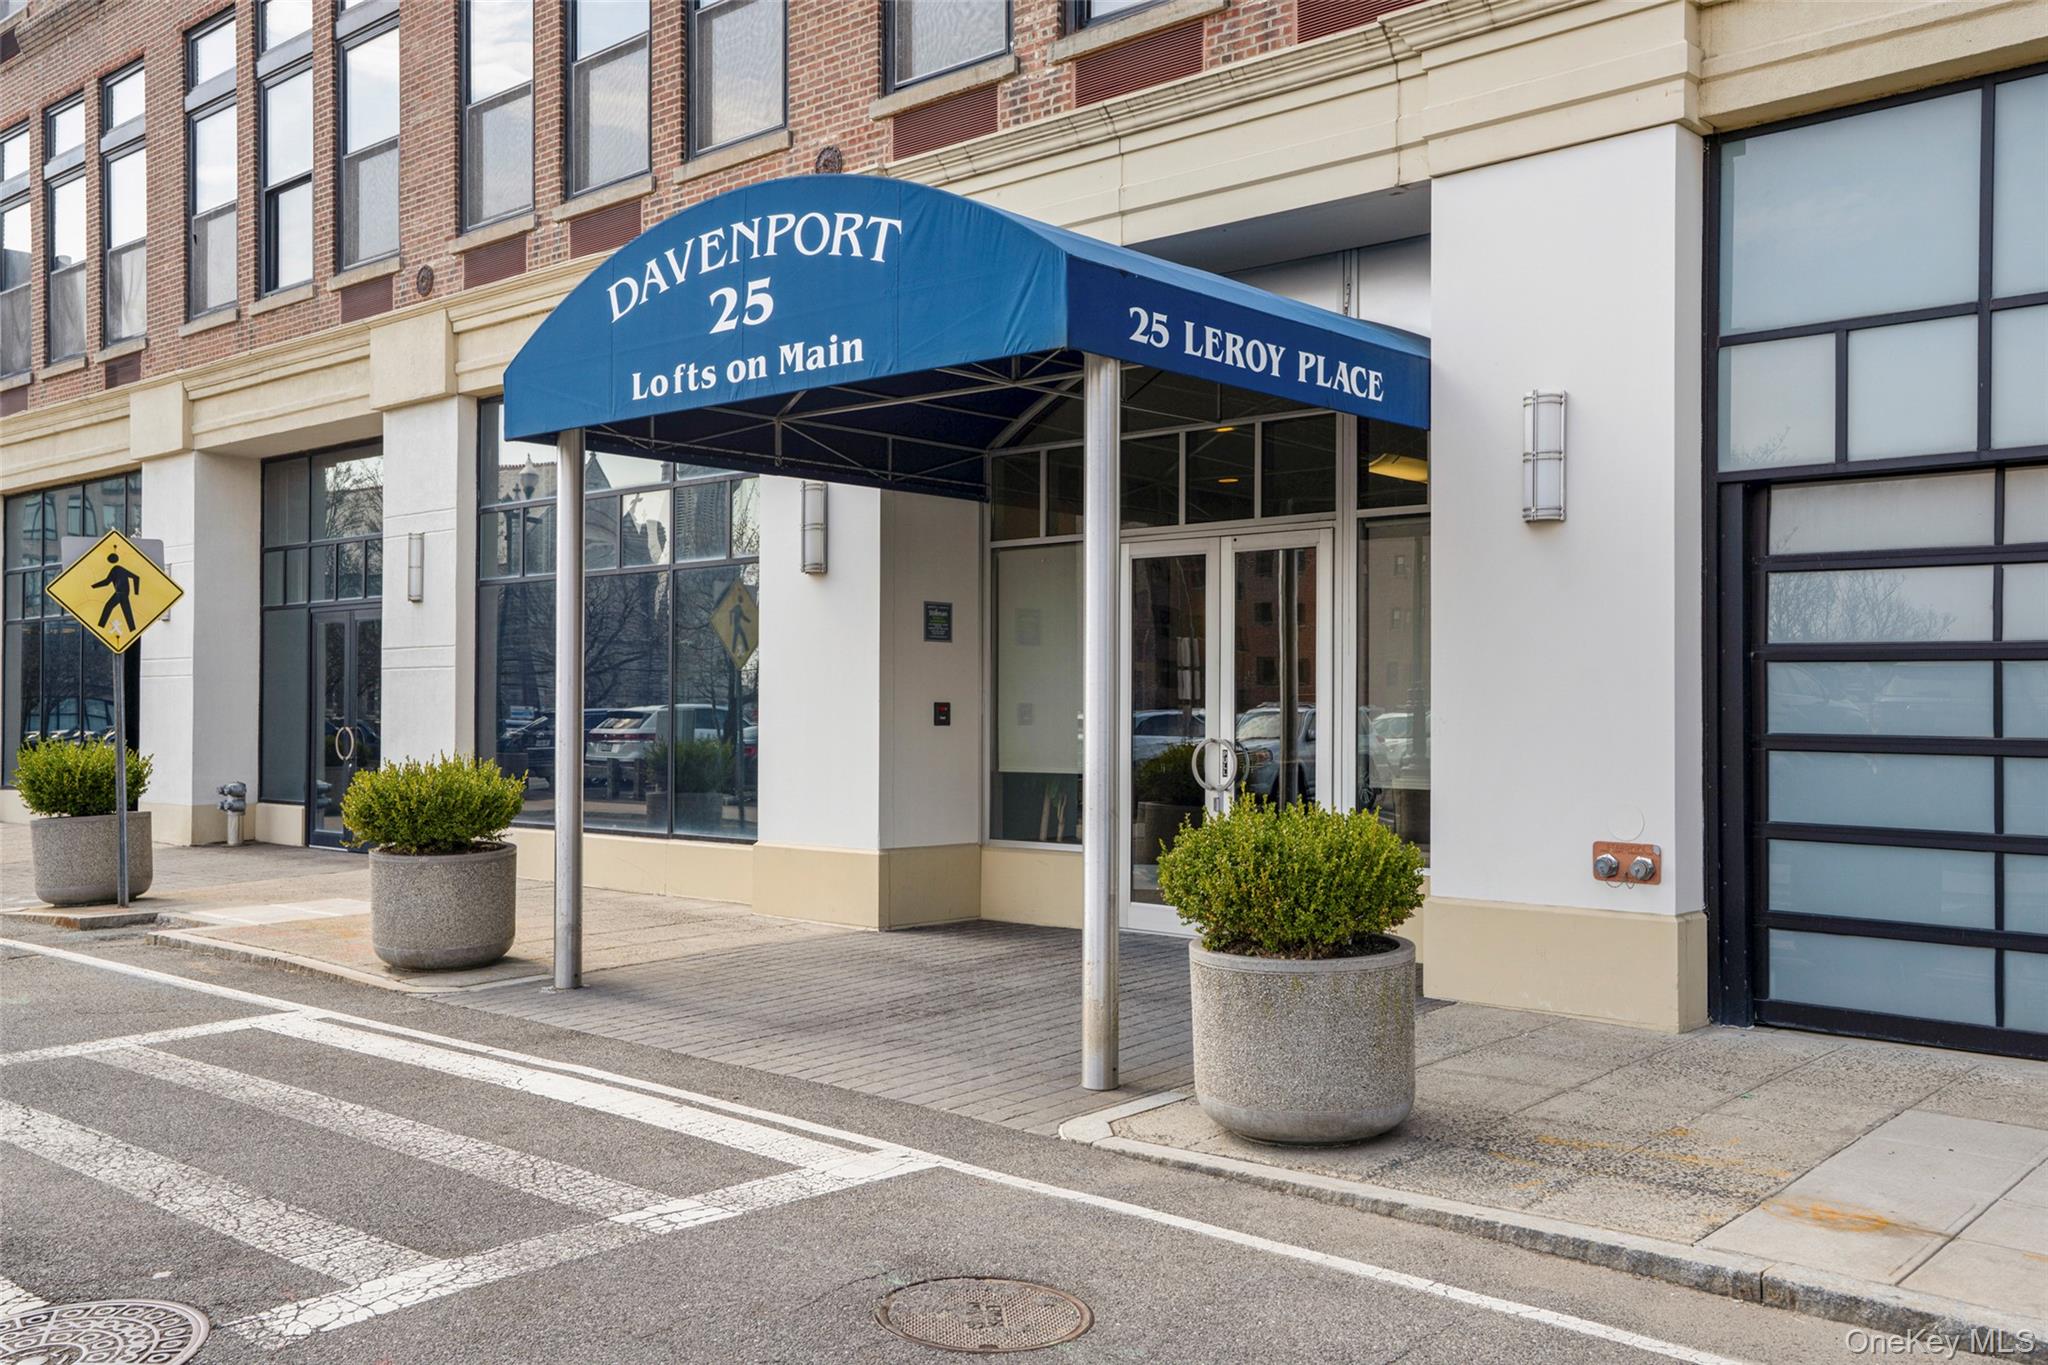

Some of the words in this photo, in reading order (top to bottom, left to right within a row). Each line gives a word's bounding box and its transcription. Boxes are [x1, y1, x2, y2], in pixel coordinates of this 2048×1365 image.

[607, 212, 902, 322] DAVENPORT
[709, 277, 774, 334] 25
[632, 362, 716, 400] Lofts
[727, 354, 767, 383] on
[779, 335, 864, 375] Main
[1129, 307, 1170, 348] 25
[1184, 321, 1285, 377] LEROY
[1298, 350, 1384, 402] PLACE
